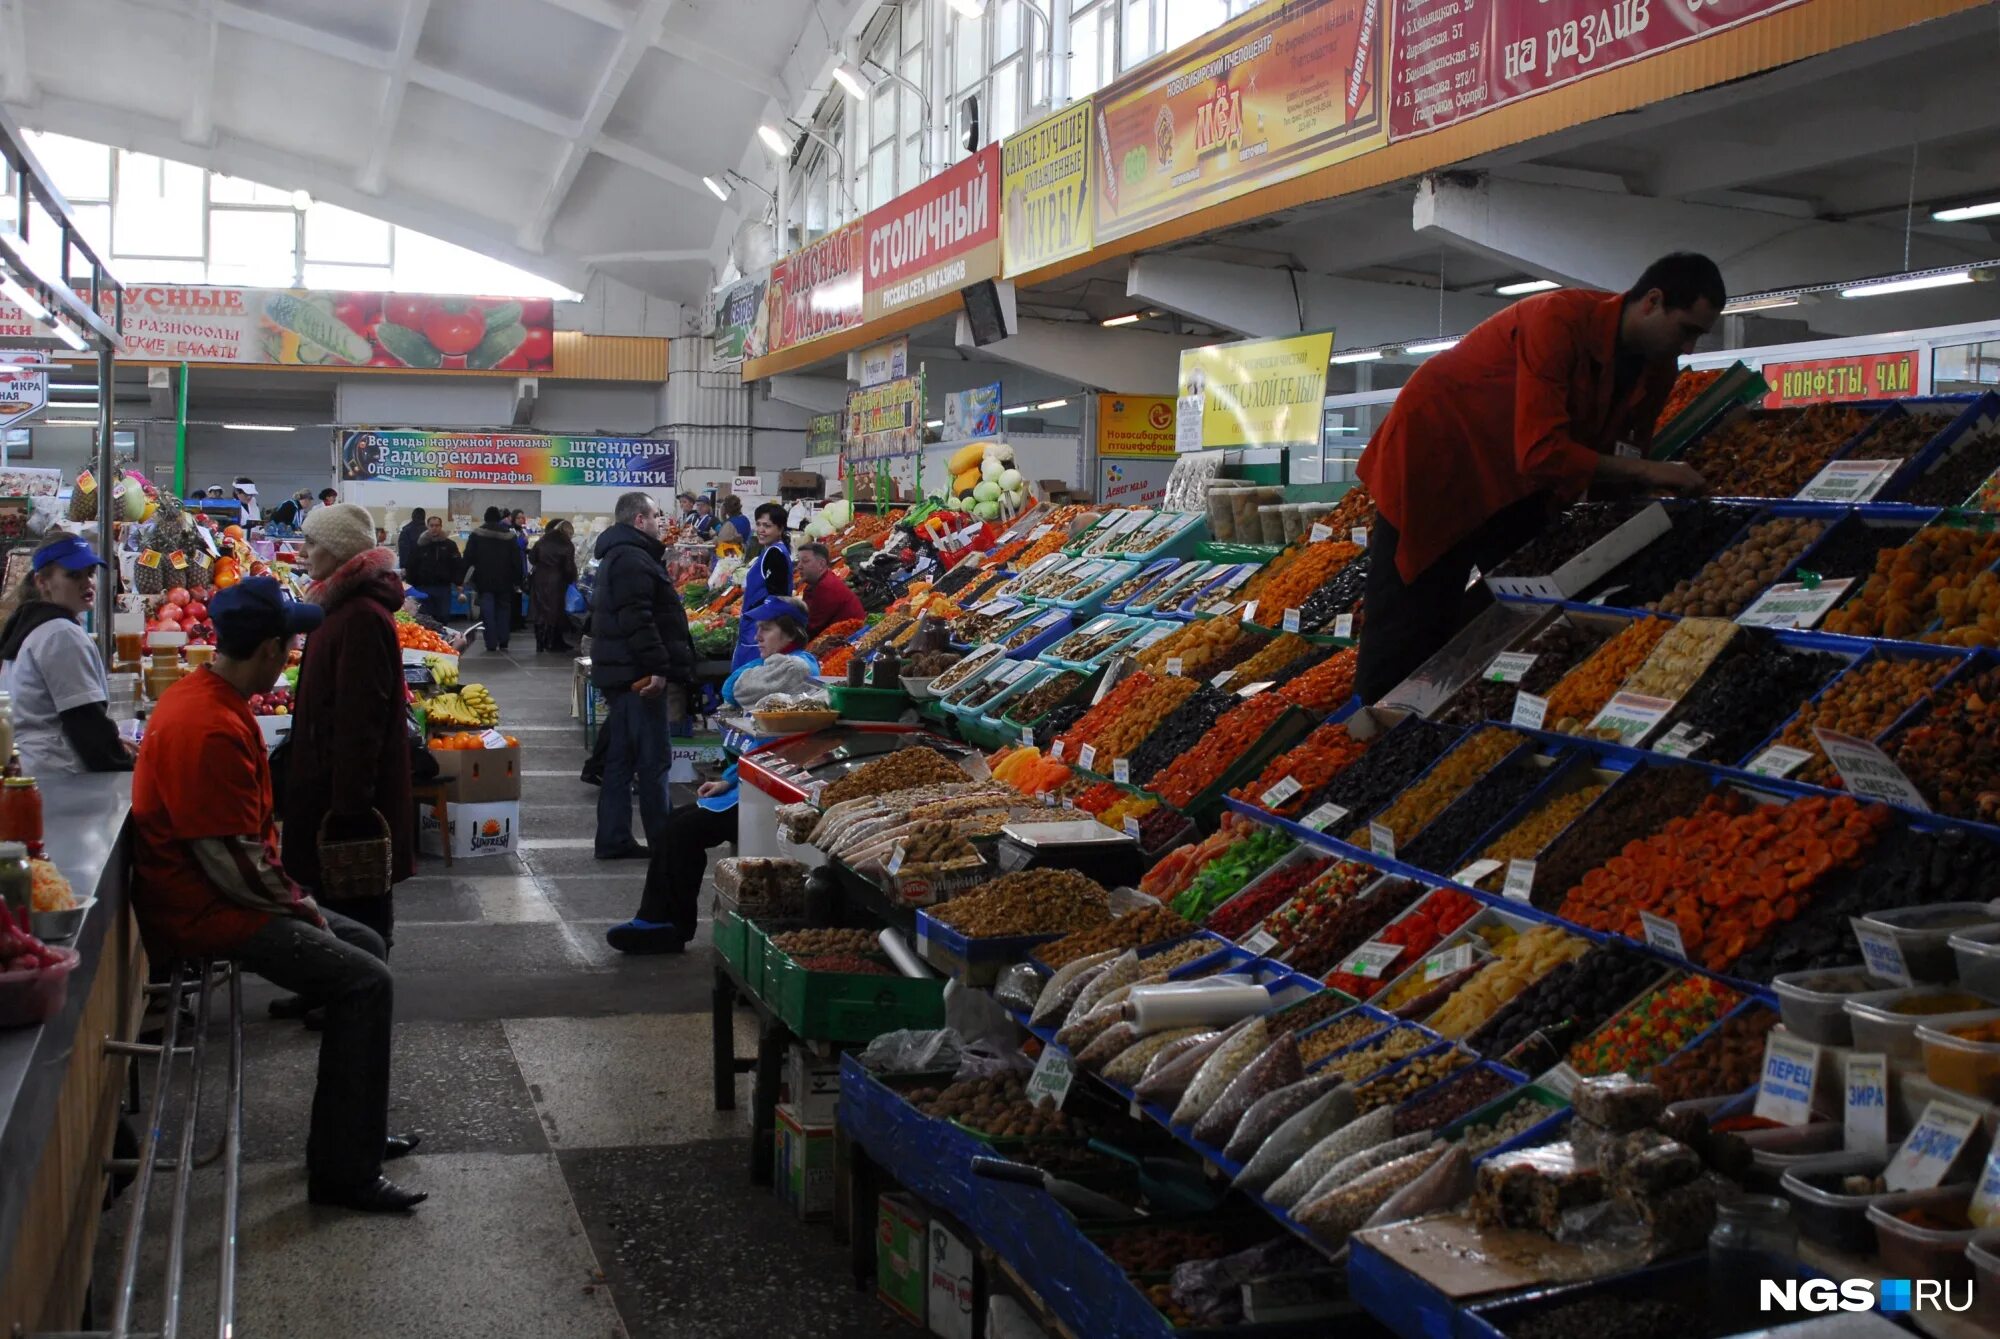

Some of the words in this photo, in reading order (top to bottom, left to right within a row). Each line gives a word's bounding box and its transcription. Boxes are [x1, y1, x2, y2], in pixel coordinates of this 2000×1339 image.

[1451, 23, 1464, 40] 57
[1504, 37, 1537, 80] на
[1545, 0, 1650, 77] разлив
[1166, 56, 1225, 98] НОВОСИБИРСКИЙ
[1224, 34, 1273, 71] ПЧЕЛОЦЕНТР
[1347, 45, 1368, 108] КИОСК
[1195, 84, 1244, 154] МЁД
[1005, 134, 1037, 177] САМЫЕ
[1040, 111, 1083, 161] ЛУЧШИЕ
[1024, 150, 1082, 195] ОХЛАЖДЕННЫЕ
[869, 159, 989, 280] СТОЛИЧНЫЙ
[1026, 184, 1073, 261] КУРЫ
[791, 228, 850, 296] МЯСНАЯ
[882, 286, 909, 310] РУССКАЯ
[909, 280, 926, 303] СЕТЬ
[926, 263, 966, 300] МАГАЗИНОВ
[138, 319, 241, 342] РАЗНОСОЛЫ
[177, 340, 238, 359] САЛАТЫ
[11, 381, 41, 391] ИКРА
[1279, 366, 1322, 406] БЕЛЫЙ
[1783, 366, 1868, 399] КОНФЕТЫ,
[1876, 358, 1910, 392] ЧАЙ
[367, 435, 389, 448] Все
[391, 438, 427, 449] виды
[429, 435, 493, 449] наружной
[495, 438, 552, 450] рекламы
[378, 446, 519, 467] Радиореклама
[569, 441, 671, 458] штендеры
[1108, 443, 1176, 453] птицефабрик
[367, 462, 452, 480] Оперативная
[455, 469, 533, 484] полиграфия
[549, 456, 627, 470] вывески
[583, 469, 667, 484] визитки
[1853, 777, 1909, 798] СМЕСЬ
[470, 832, 511, 852] SUNFRESH
[1766, 1057, 1813, 1089] ПЕРЕЦ
[1847, 1084, 1885, 1108] ЗИРА
